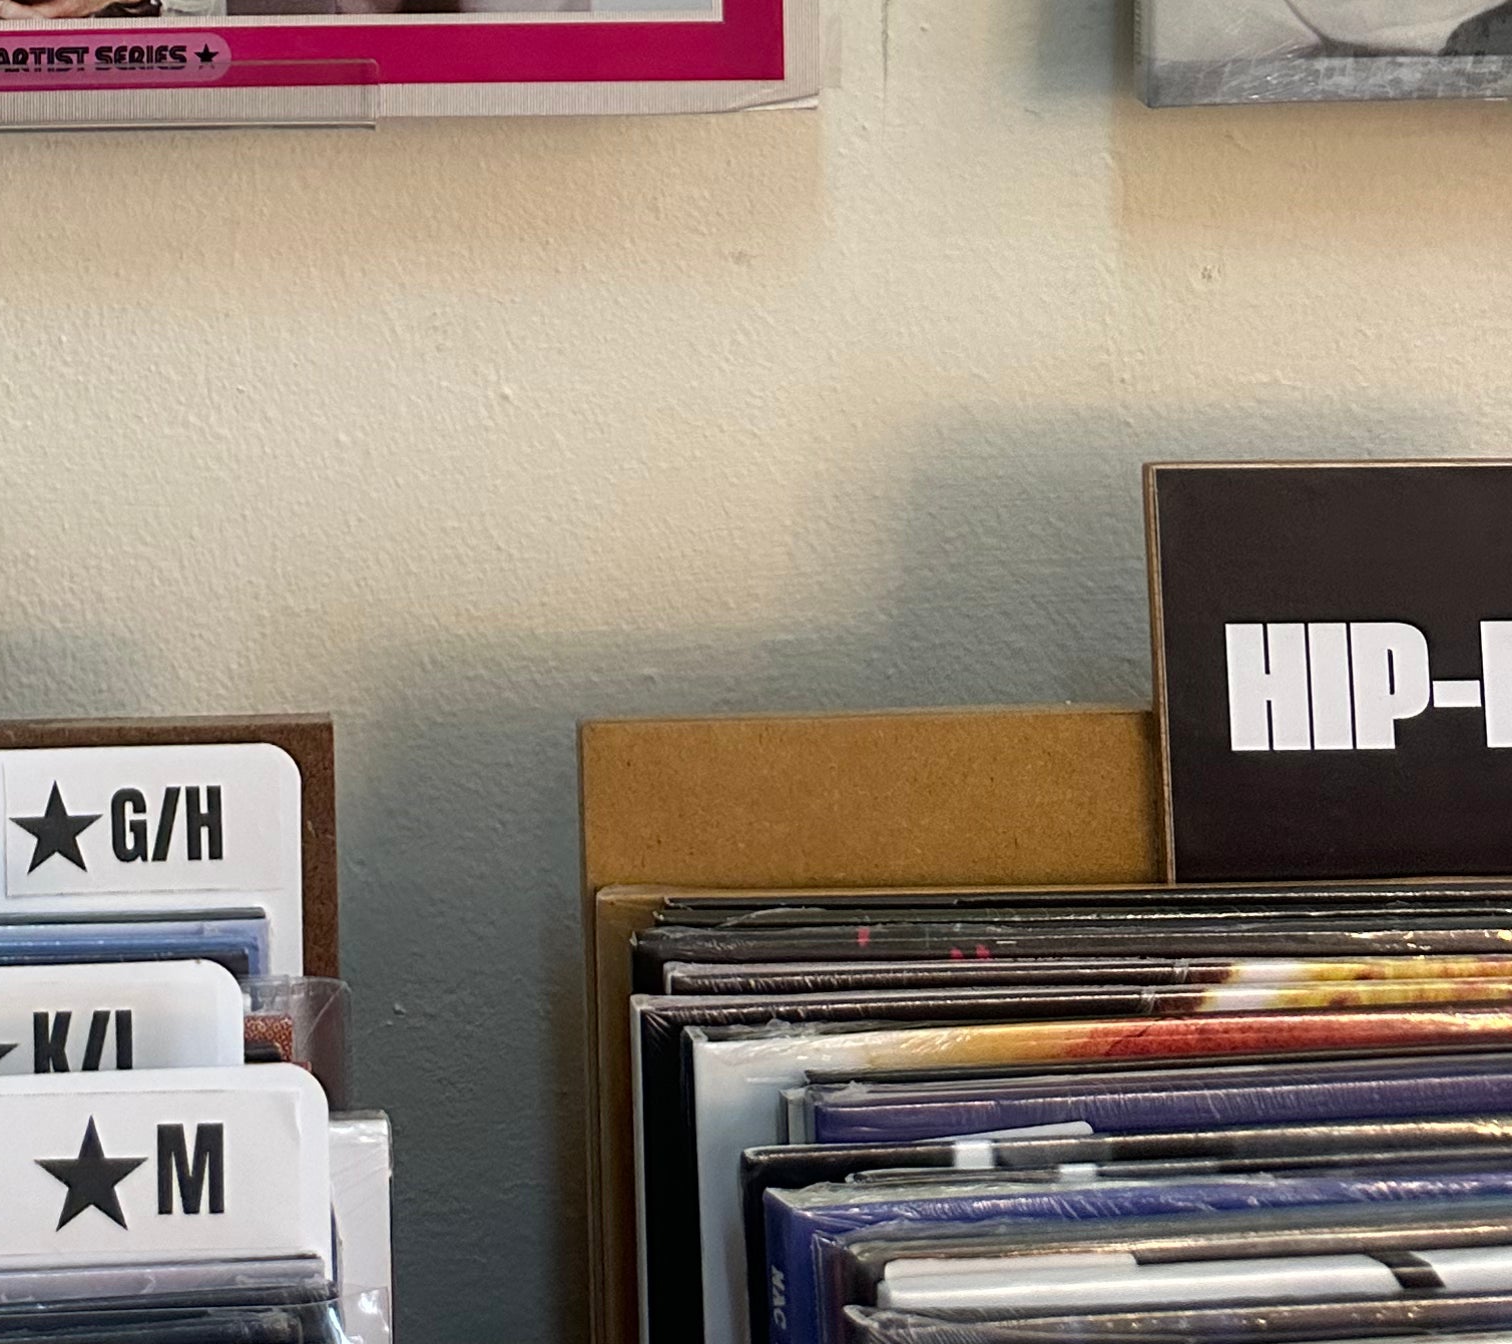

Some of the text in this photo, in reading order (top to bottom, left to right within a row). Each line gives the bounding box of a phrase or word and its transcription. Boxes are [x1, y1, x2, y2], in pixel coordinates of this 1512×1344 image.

[95, 45, 187, 71] SERIES
[111, 784, 224, 863] G/H
[156, 1122, 225, 1215] M
